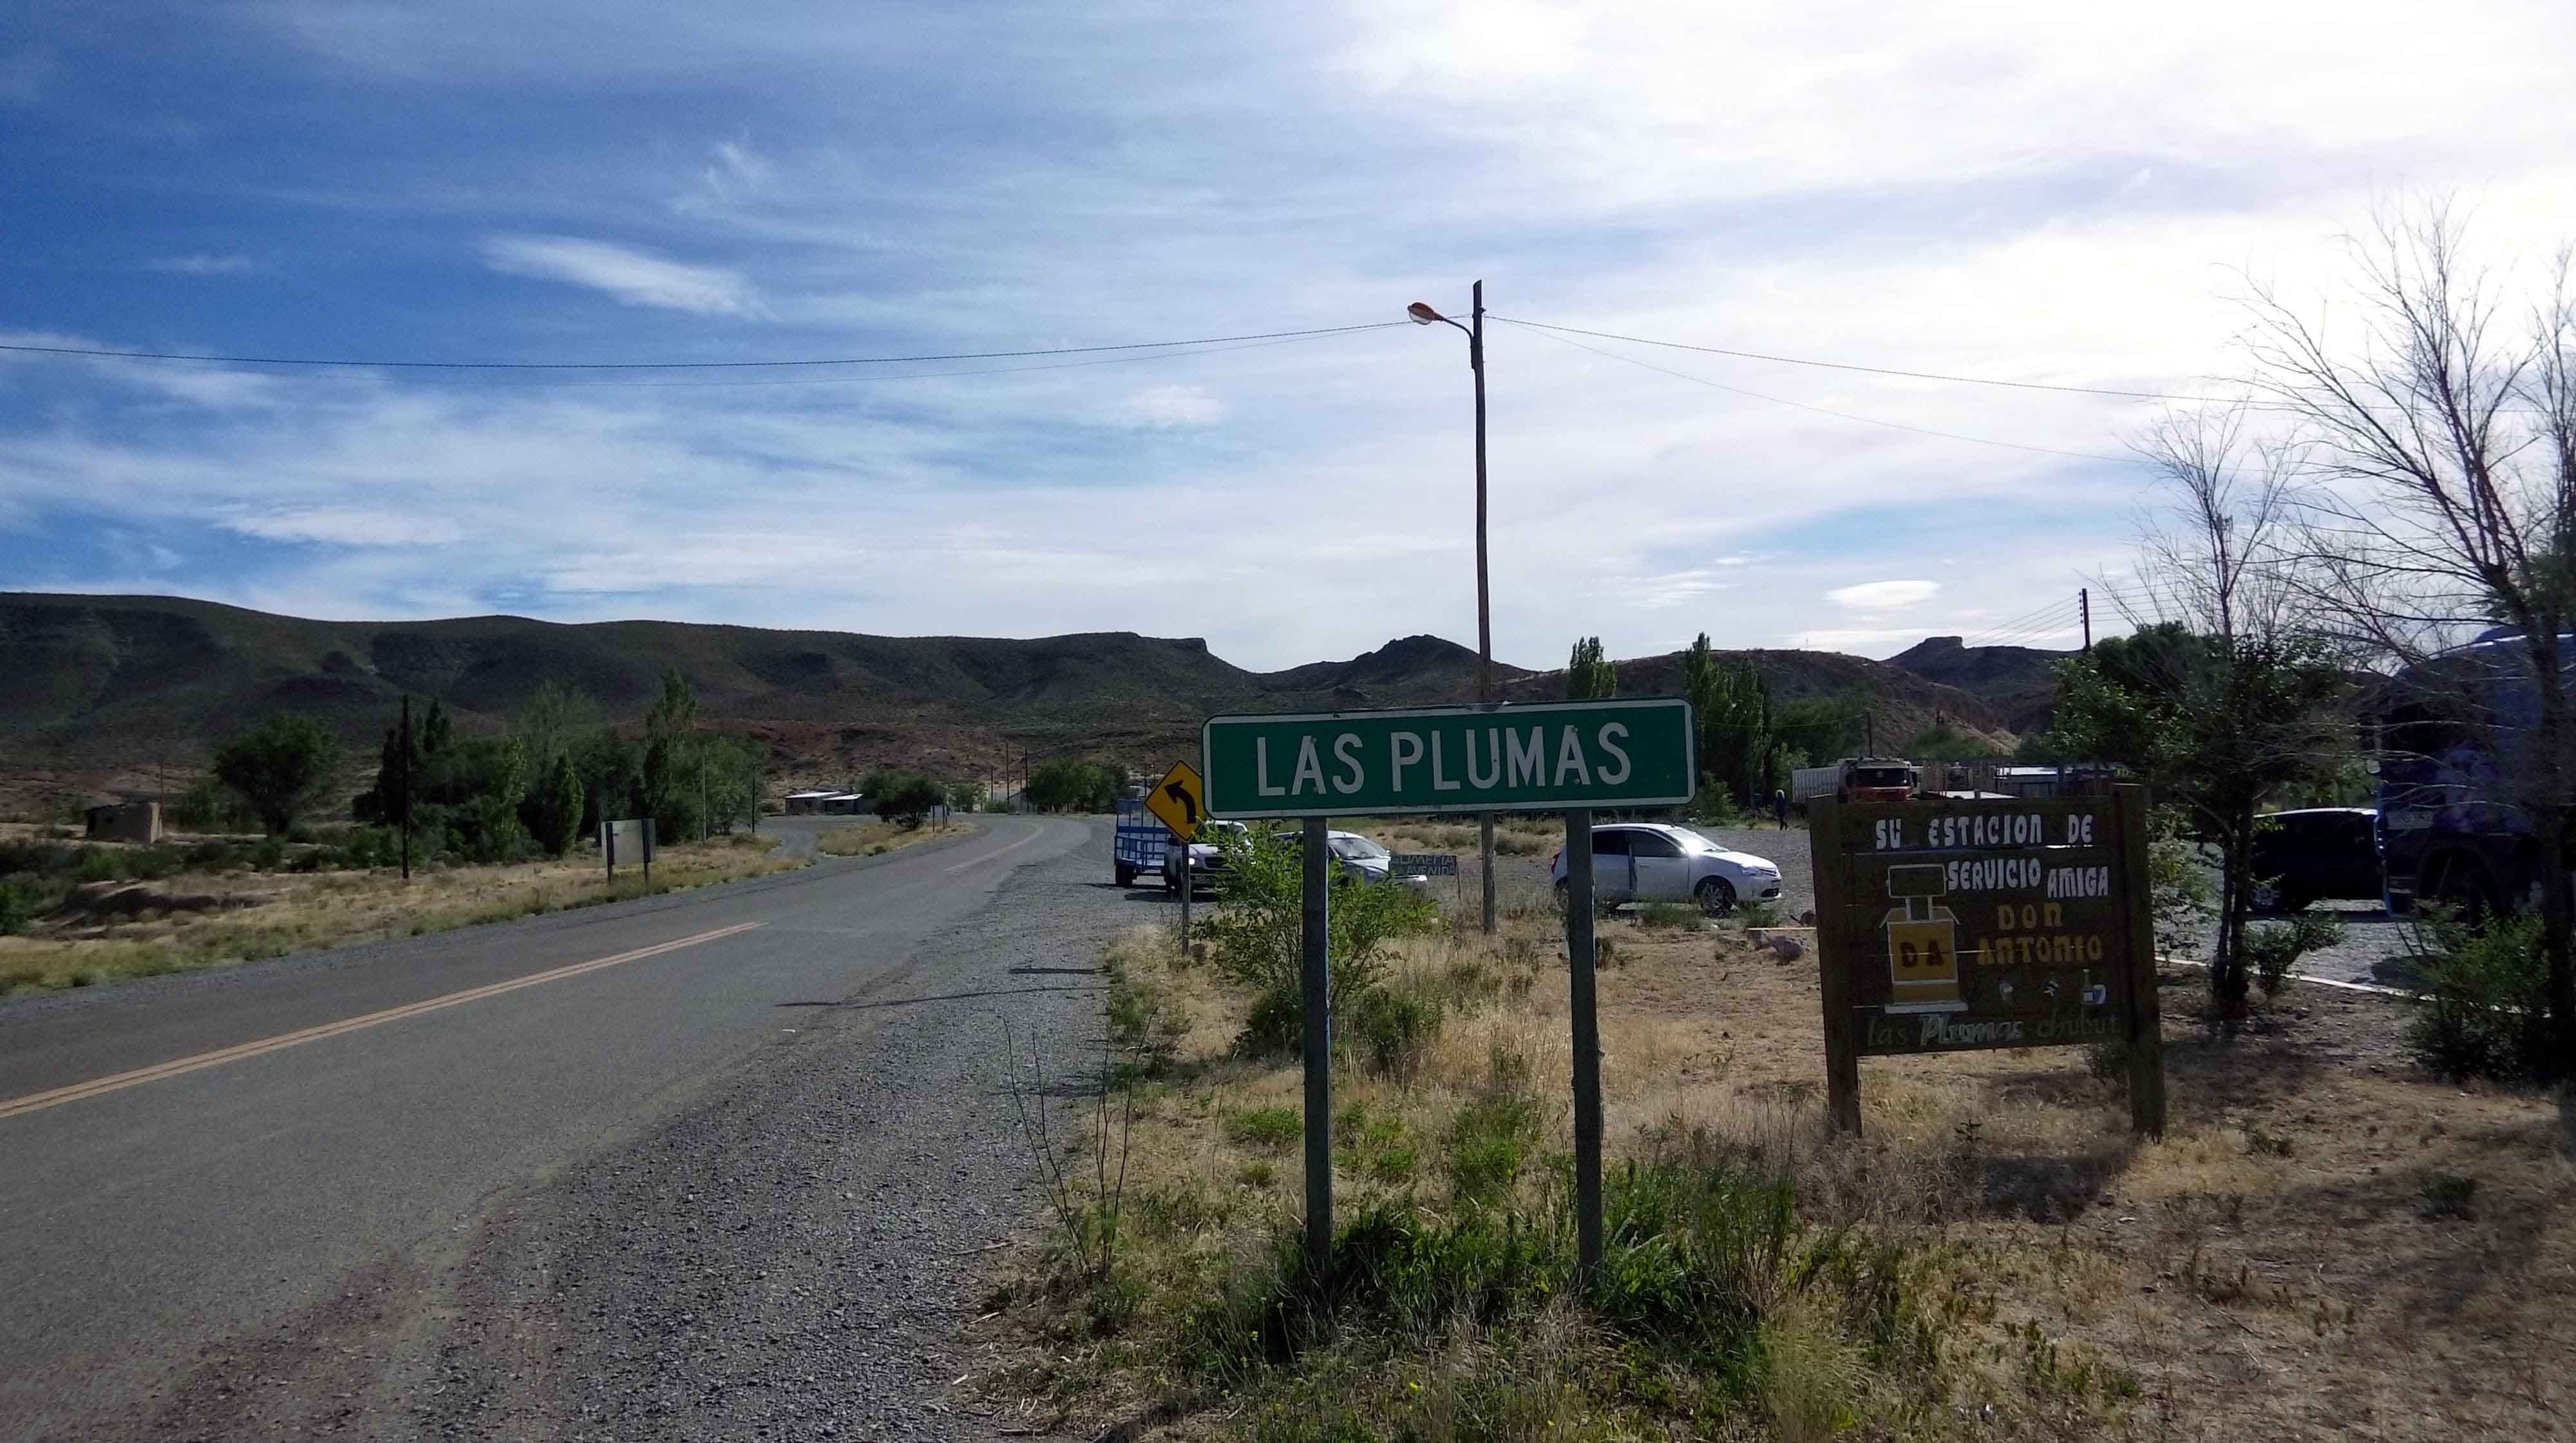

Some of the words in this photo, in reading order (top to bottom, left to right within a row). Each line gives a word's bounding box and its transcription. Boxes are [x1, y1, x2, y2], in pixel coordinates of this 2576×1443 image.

[1256, 732, 1365, 796] LAS
[1390, 722, 1631, 792] PLUMAS
[1875, 818, 1902, 850] SU
[1927, 814, 2042, 848] ESTACION
[2067, 814, 2094, 844] DE
[1947, 857, 2041, 892] SERVICIO
[2047, 866, 2109, 898] AMIGA
[1998, 902, 2062, 931] DON
[1977, 934, 2103, 966] ANTONIO
